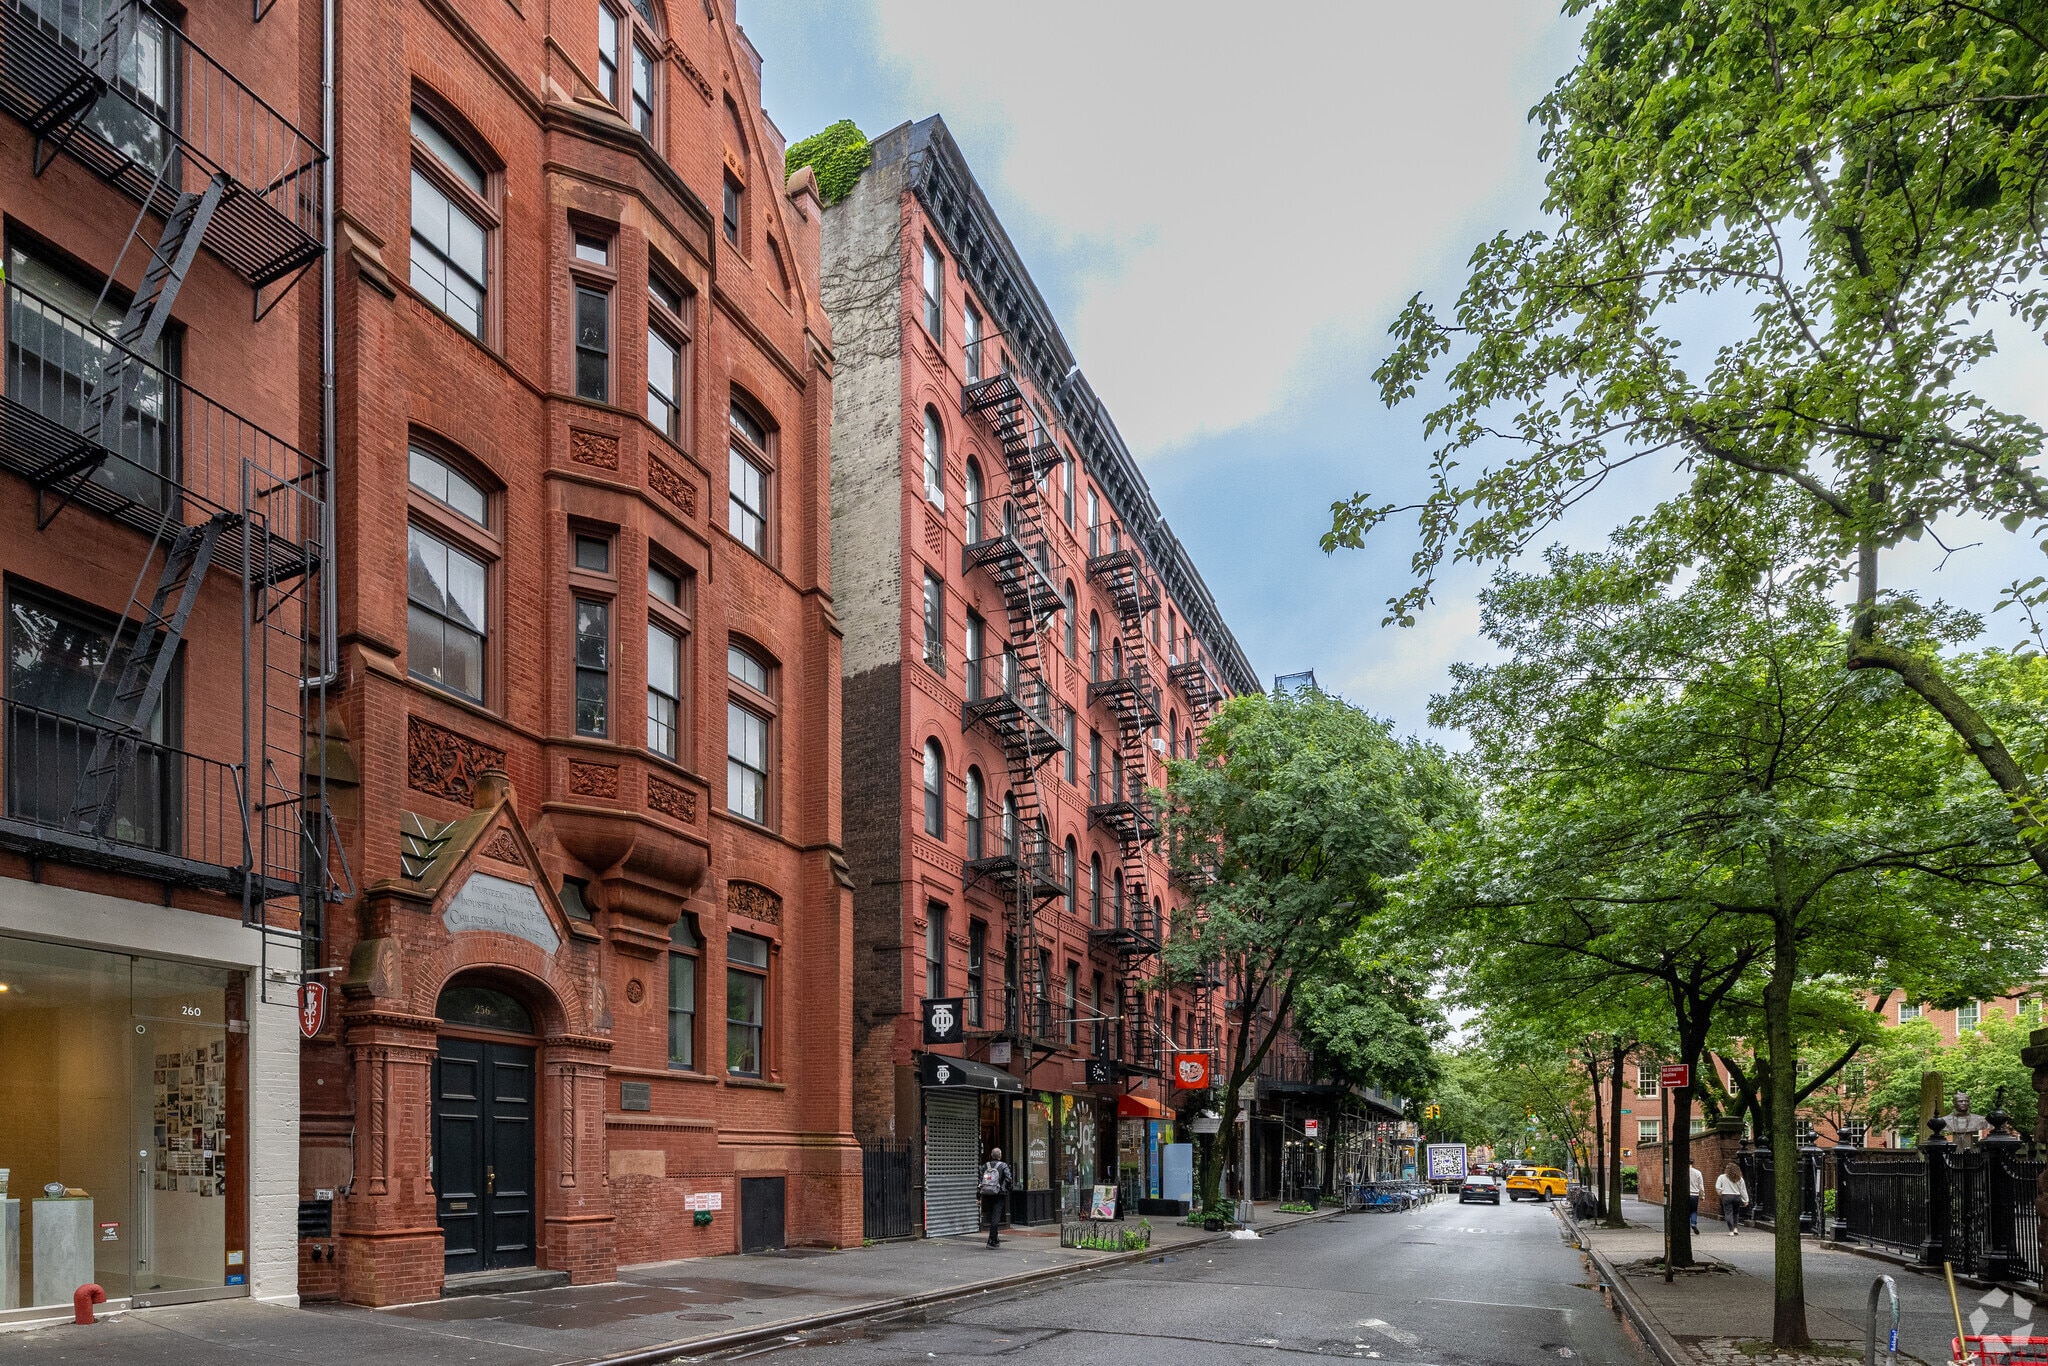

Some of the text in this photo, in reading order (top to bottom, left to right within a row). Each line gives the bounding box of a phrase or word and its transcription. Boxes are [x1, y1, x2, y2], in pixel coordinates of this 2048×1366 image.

[182, 1006, 201, 1017] 260
[475, 1004, 490, 1015] 256
[1030, 1149, 1046, 1158] MARKET
